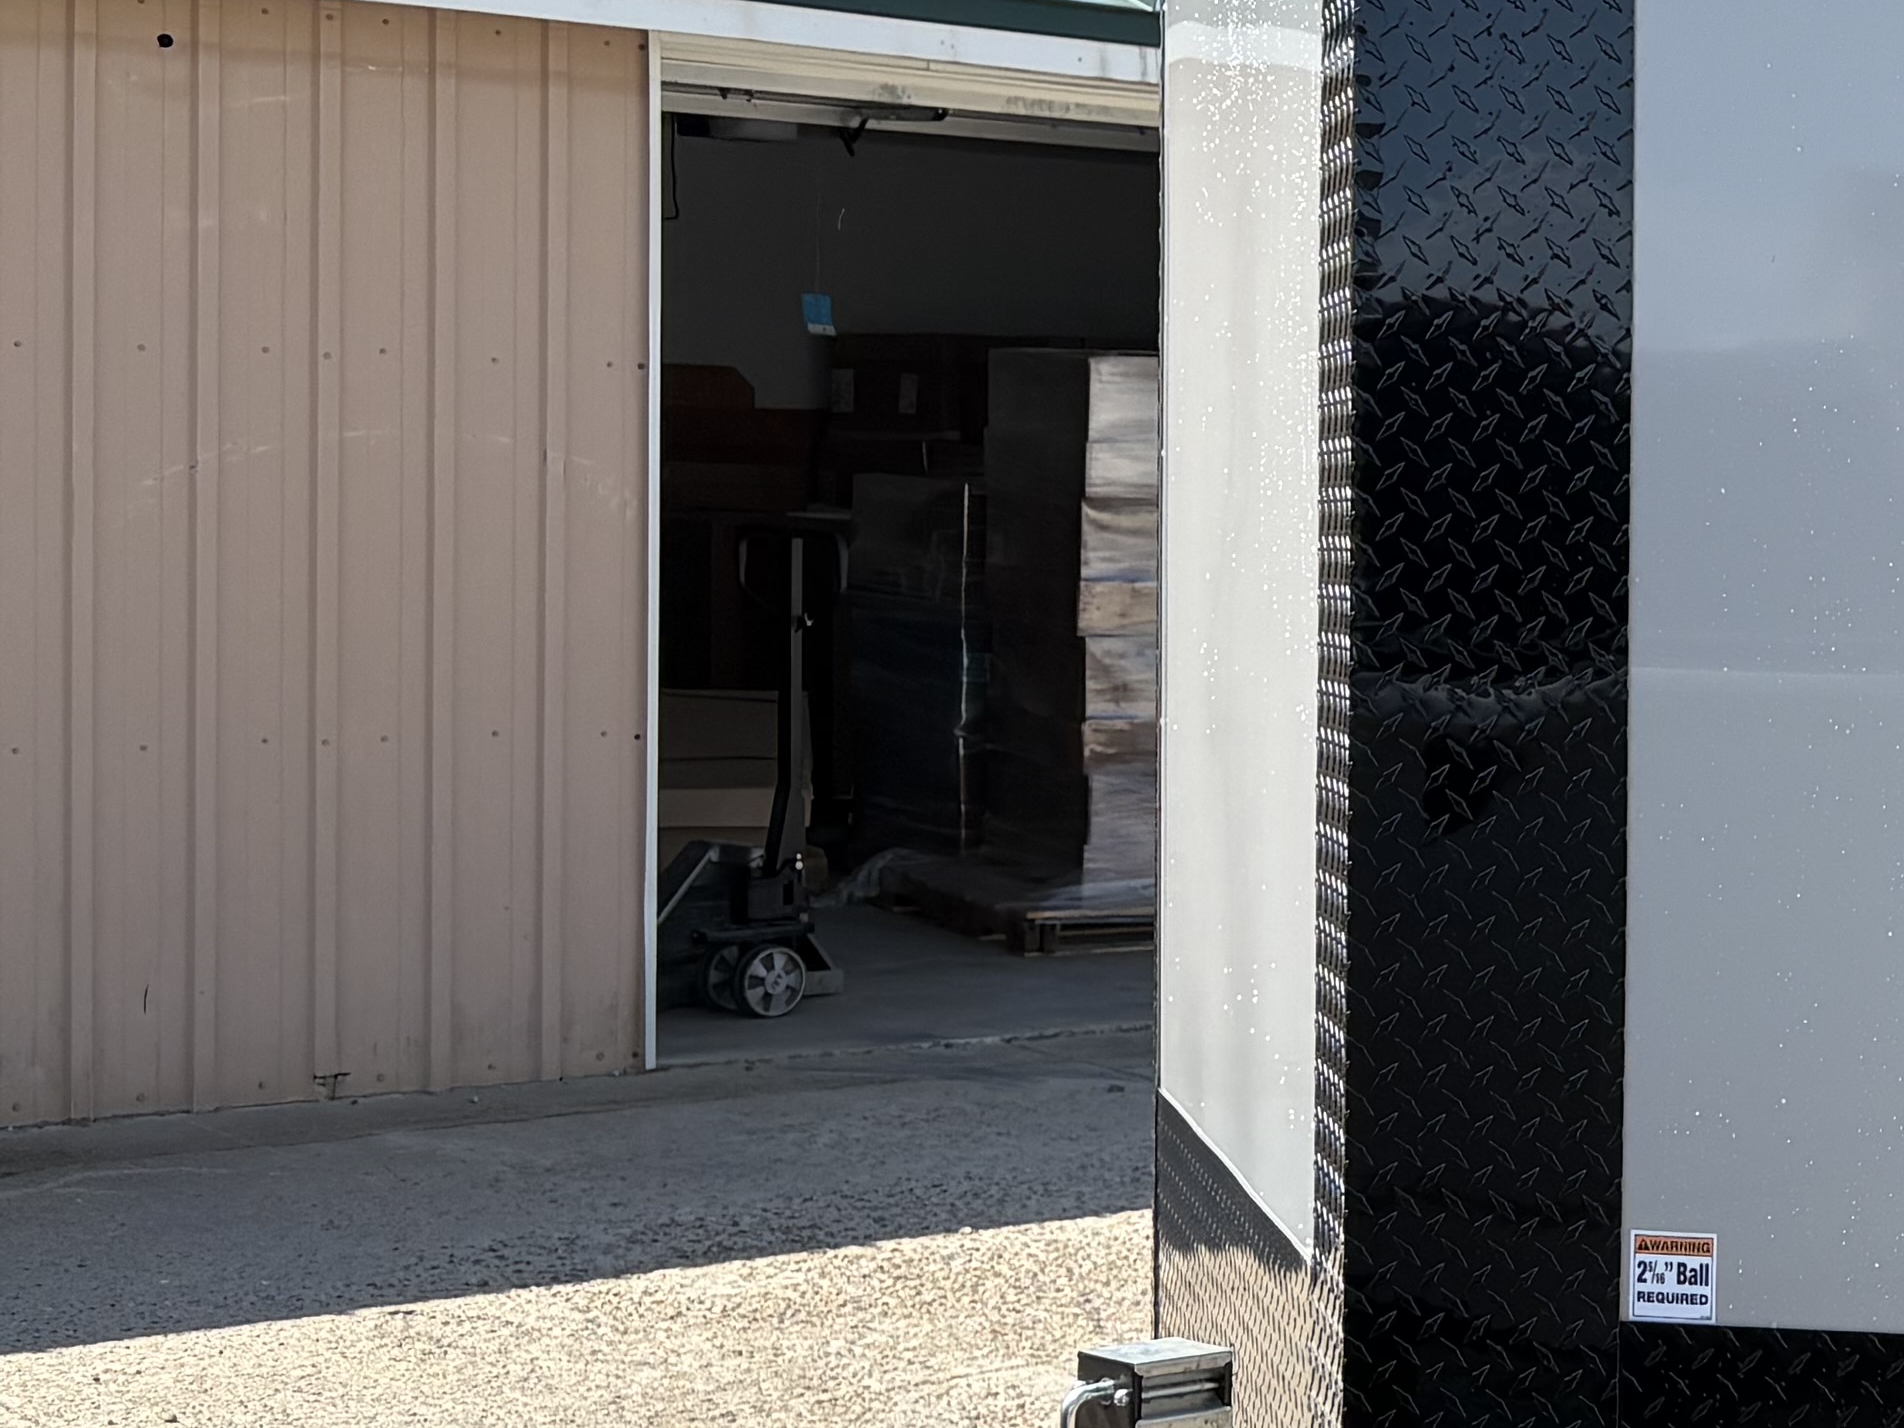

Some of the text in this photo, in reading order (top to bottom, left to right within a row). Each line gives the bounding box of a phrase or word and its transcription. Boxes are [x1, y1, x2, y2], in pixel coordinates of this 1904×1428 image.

[1650, 1240, 1711, 1254] WARNING
[1677, 1261, 1710, 1287] Ball
[1636, 1290, 1709, 1306] REQUIRED
